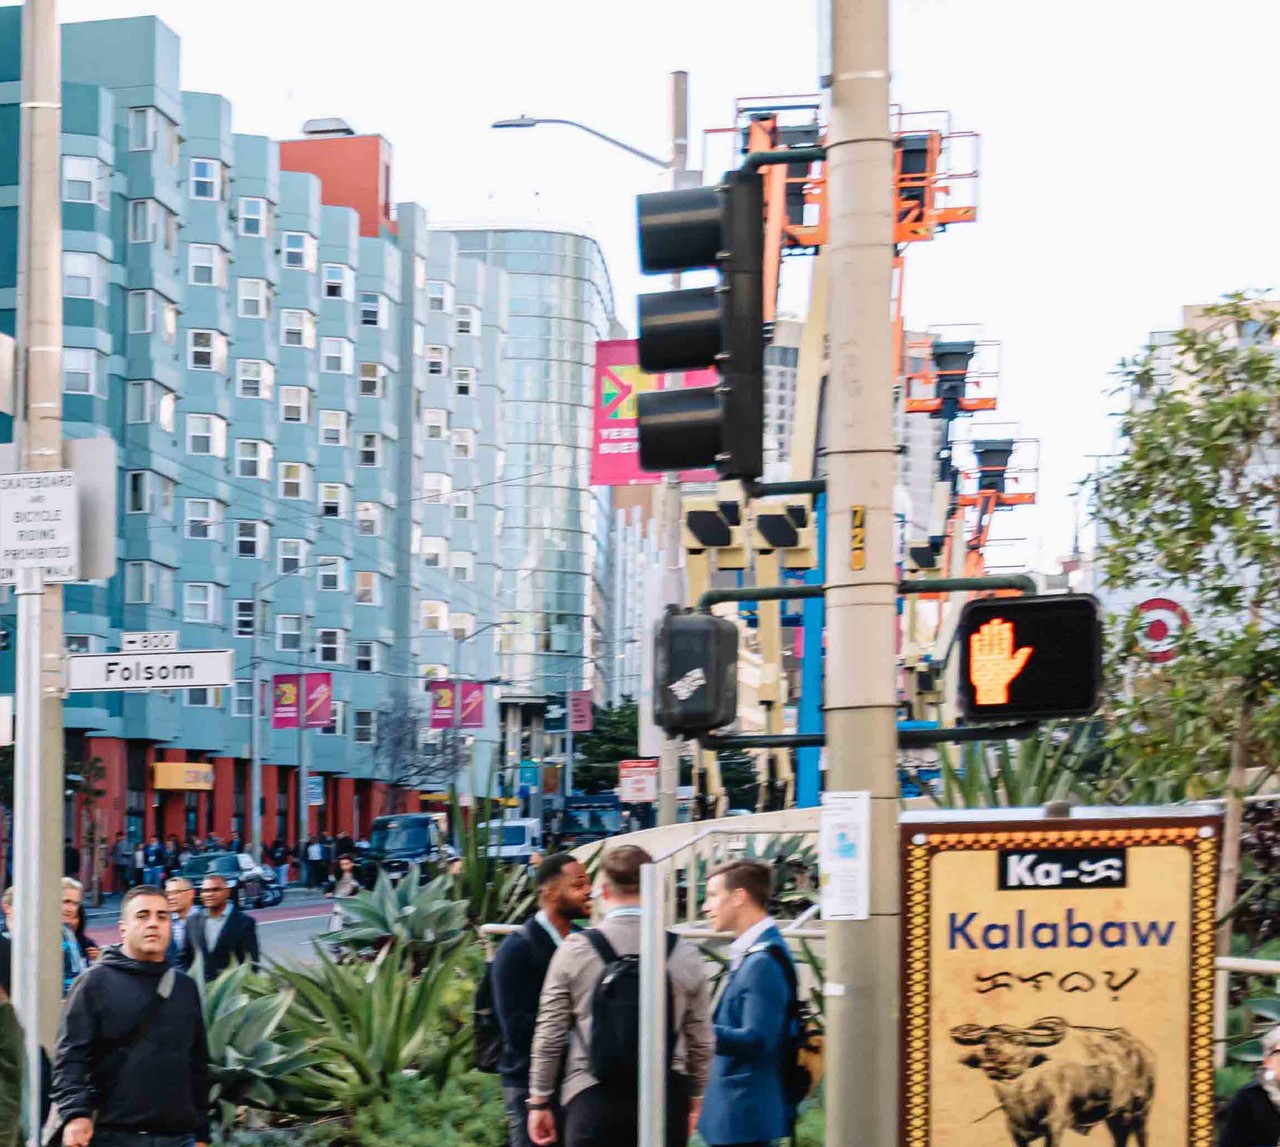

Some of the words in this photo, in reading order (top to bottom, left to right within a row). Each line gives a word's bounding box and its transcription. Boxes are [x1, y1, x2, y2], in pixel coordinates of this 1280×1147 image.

[599, 427, 639, 440] YER
[598, 441, 639, 455] BUE
[13, 510, 62, 524] BICYCLE
[17, 529, 56, 542] RIDING
[2, 546, 71, 560] PROHIBITED
[104, 661, 195, 682] Folsom
[947, 907, 1177, 951] Kalabaw
